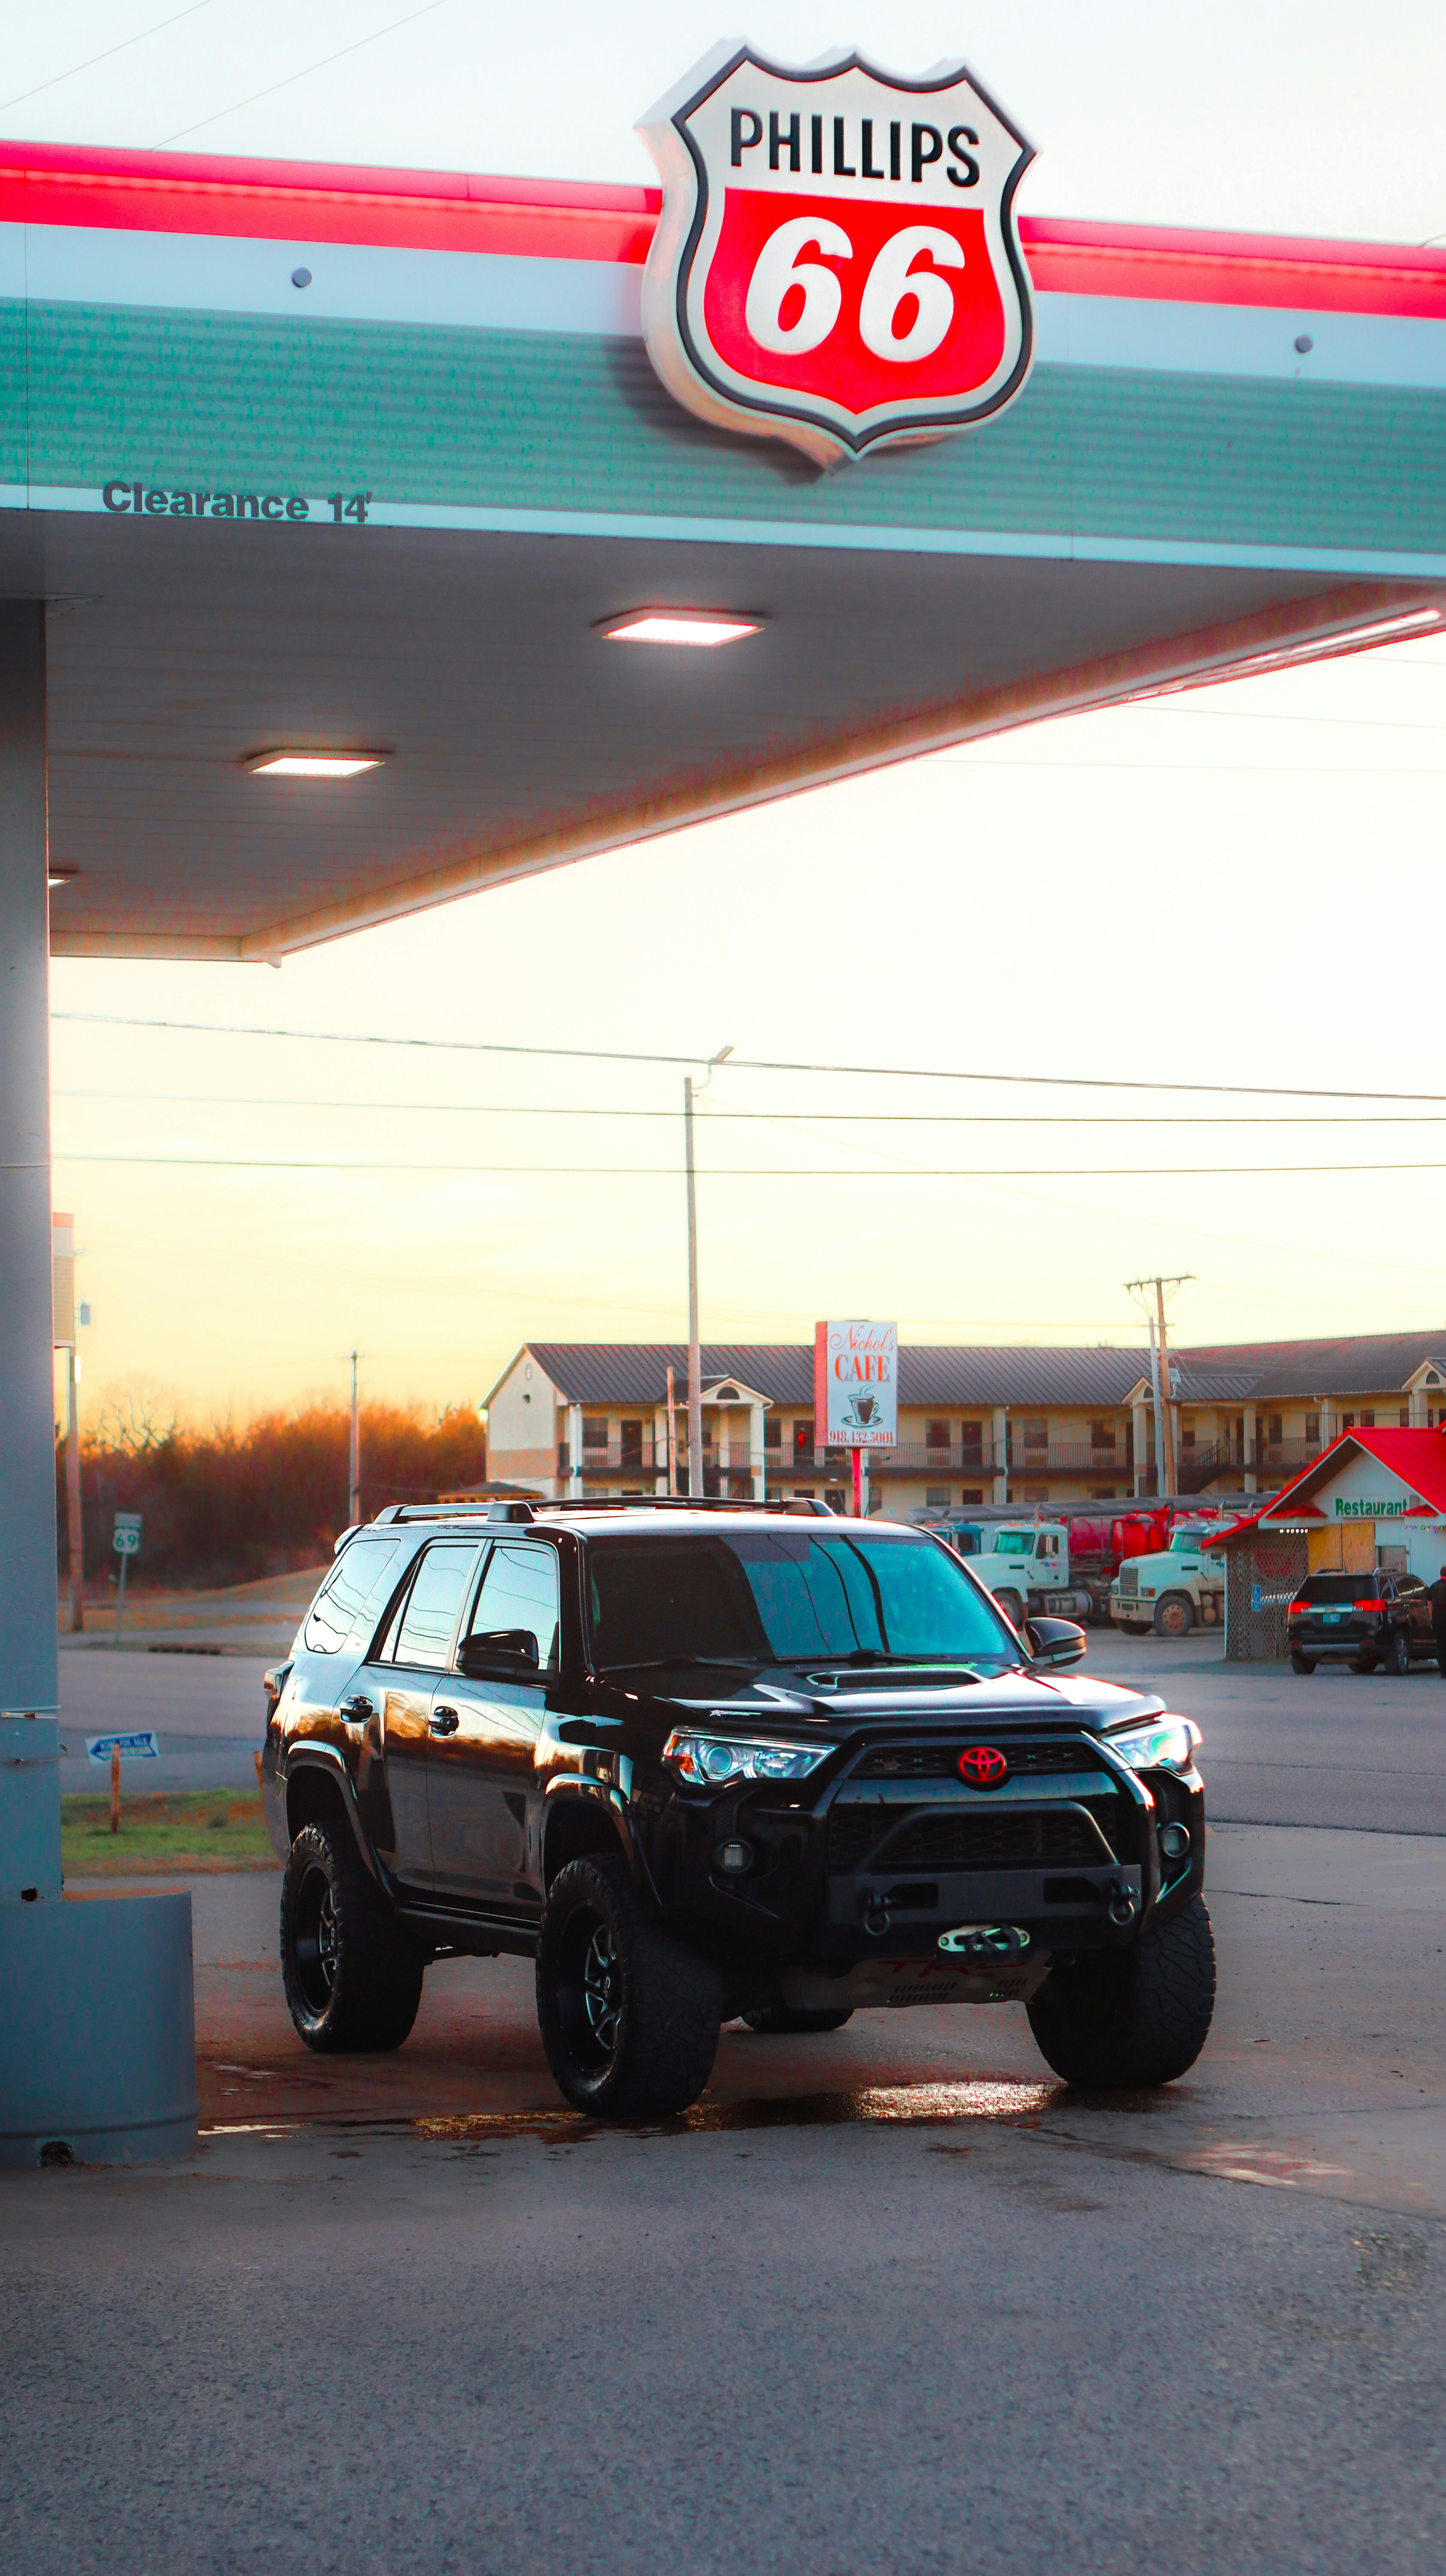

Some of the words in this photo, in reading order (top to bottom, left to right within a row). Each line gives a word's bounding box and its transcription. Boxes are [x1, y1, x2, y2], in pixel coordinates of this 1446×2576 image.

[731, 107, 980, 188] PHILLIPS
[745, 216, 965, 362] 66
[102, 480, 310, 520] Clearance
[328, 492, 373, 523] 14'
[829, 1325, 894, 1351] Nichol's
[835, 1355, 890, 1382] CAFE
[1335, 1498, 1407, 1516] Restaurant
[116, 1532, 137, 1548] 69
